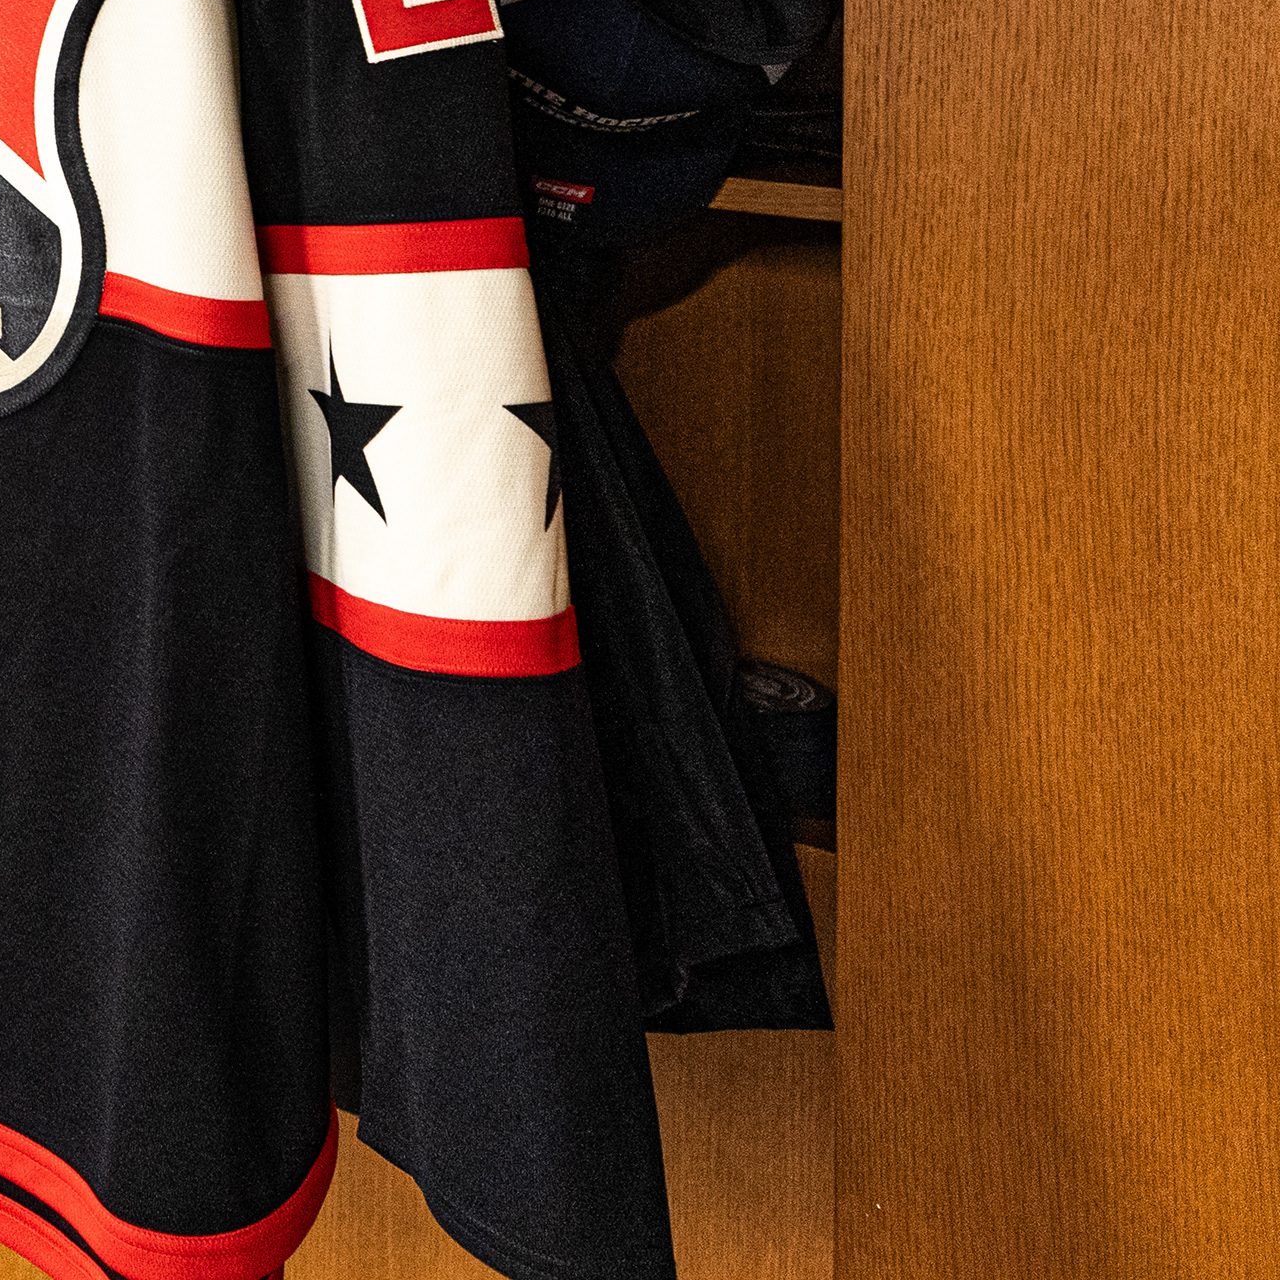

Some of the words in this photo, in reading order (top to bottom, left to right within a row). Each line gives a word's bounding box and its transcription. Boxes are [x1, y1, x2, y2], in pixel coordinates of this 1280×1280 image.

[536, 181, 588, 199] CCM
[557, 201, 576, 213] SIZE
[558, 211, 573, 221] ALL
